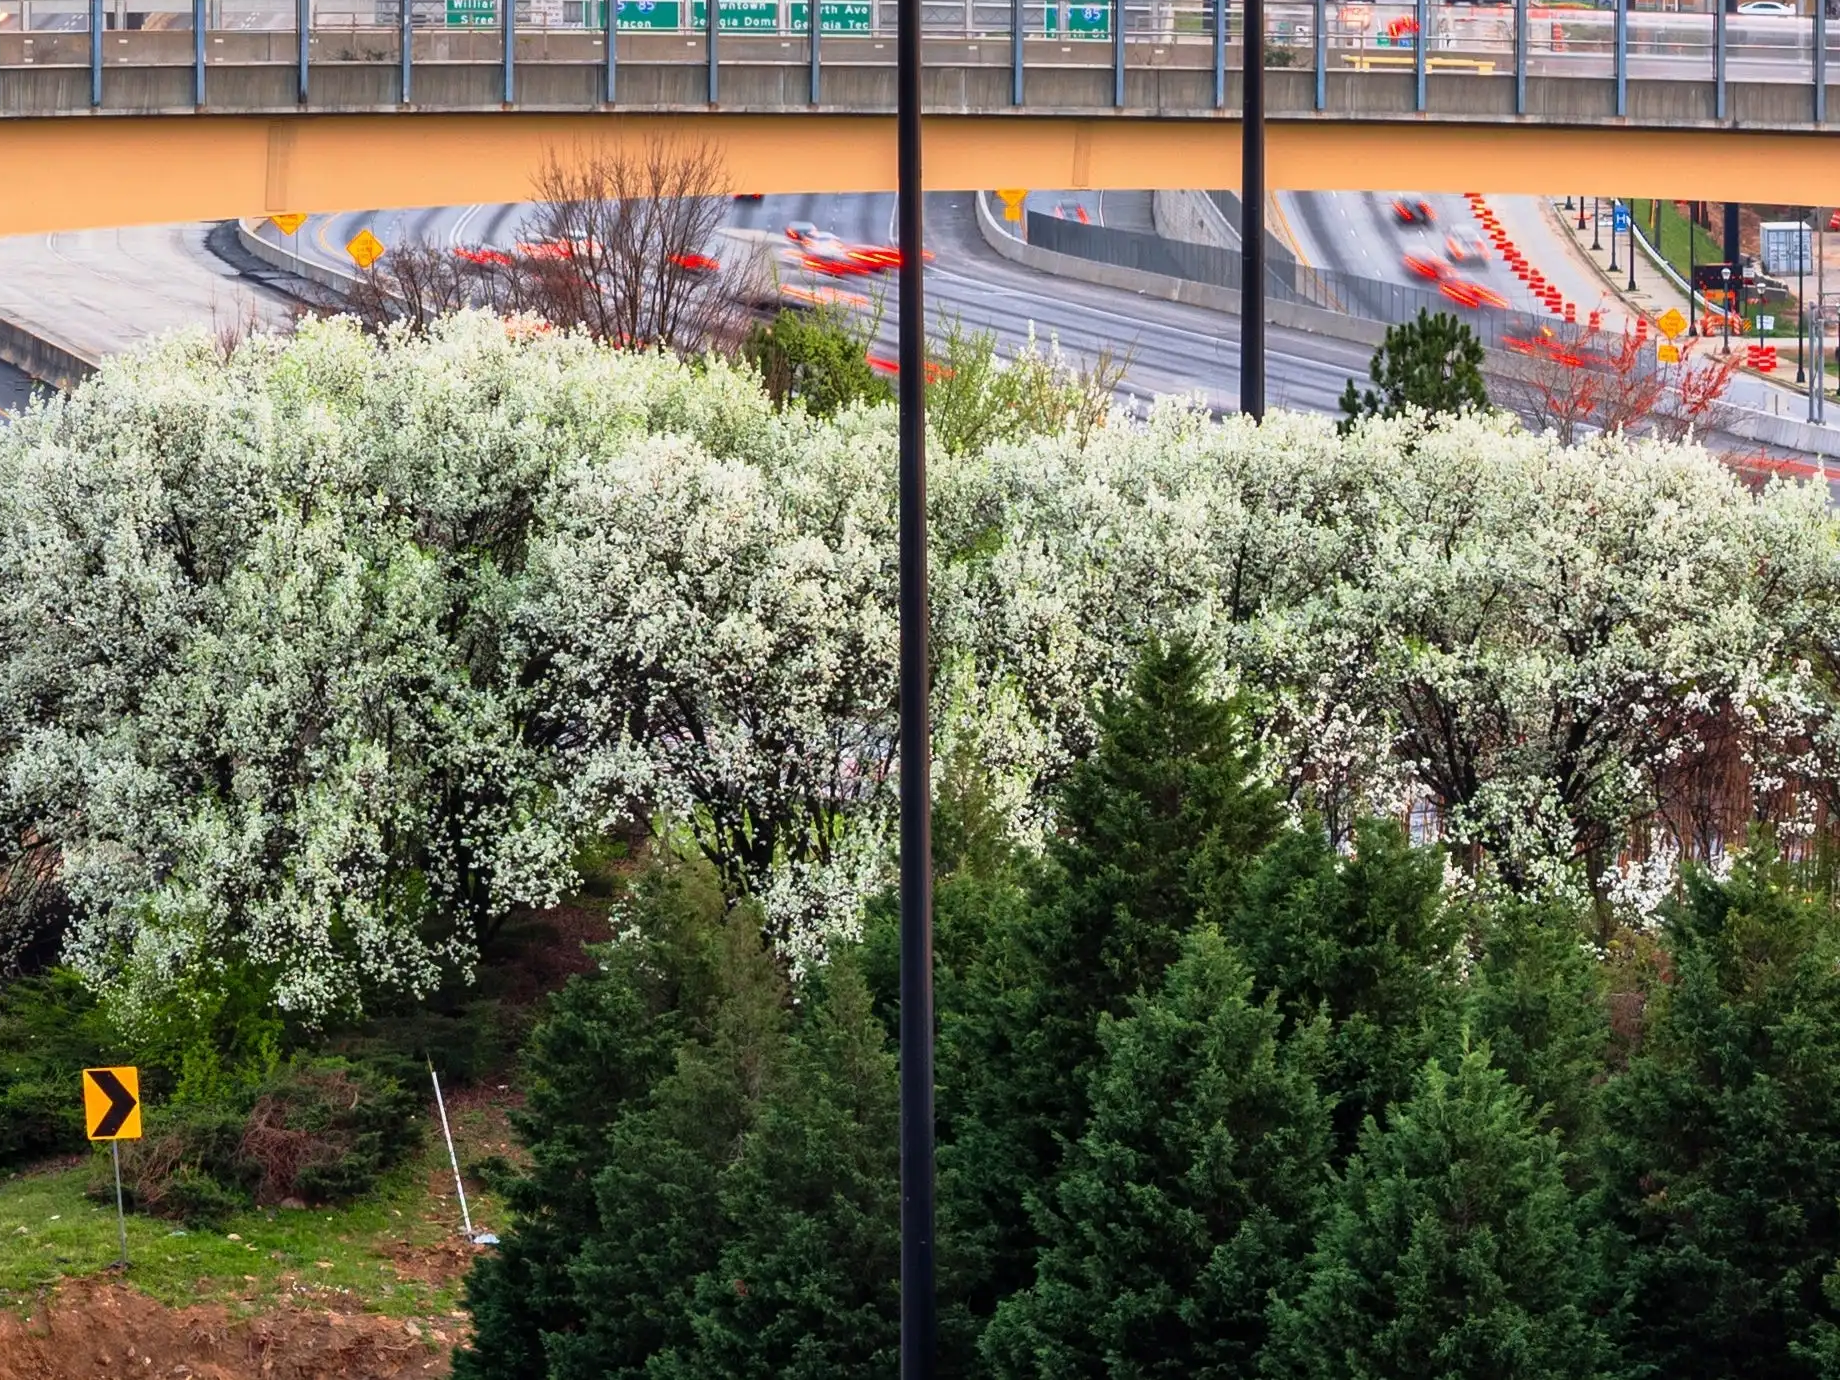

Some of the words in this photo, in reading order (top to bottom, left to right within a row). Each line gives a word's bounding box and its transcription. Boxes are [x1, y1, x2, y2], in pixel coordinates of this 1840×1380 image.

[638, 0, 655, 10] 85
[802, 5, 838, 15] Nrth
[845, 5, 868, 15] Ave
[1084, 8, 1101, 20] 85
[794, 20, 841, 30] Gegia
[848, 20, 869, 30] Tec
[1616, 213, 1626, 224] H
